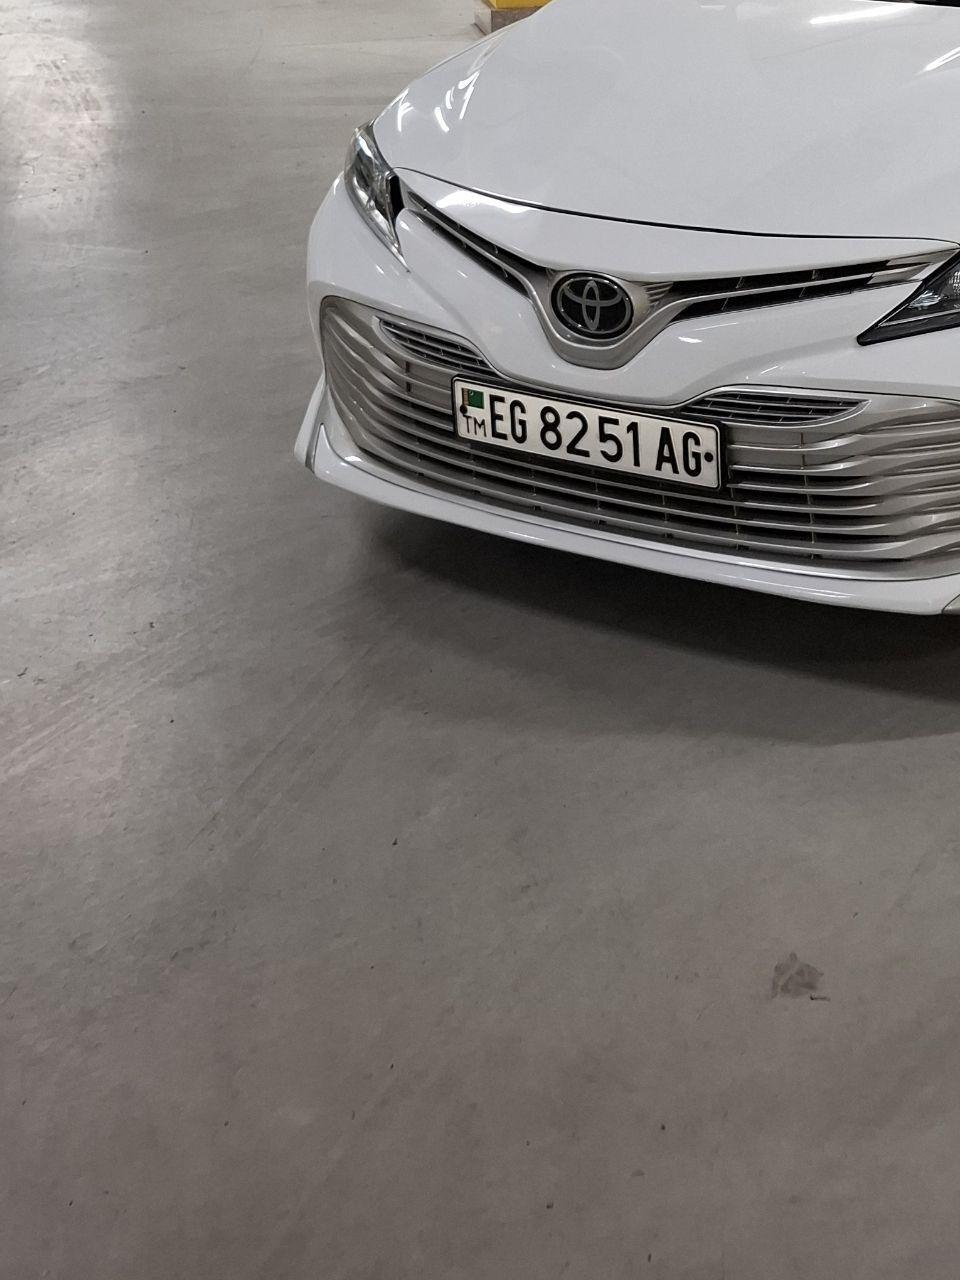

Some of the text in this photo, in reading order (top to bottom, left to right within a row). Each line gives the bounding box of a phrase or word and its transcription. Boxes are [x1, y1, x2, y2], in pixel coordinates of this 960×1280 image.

[463, 415, 487, 437] TM
[489, 394, 702, 477] EG 8251 AG
